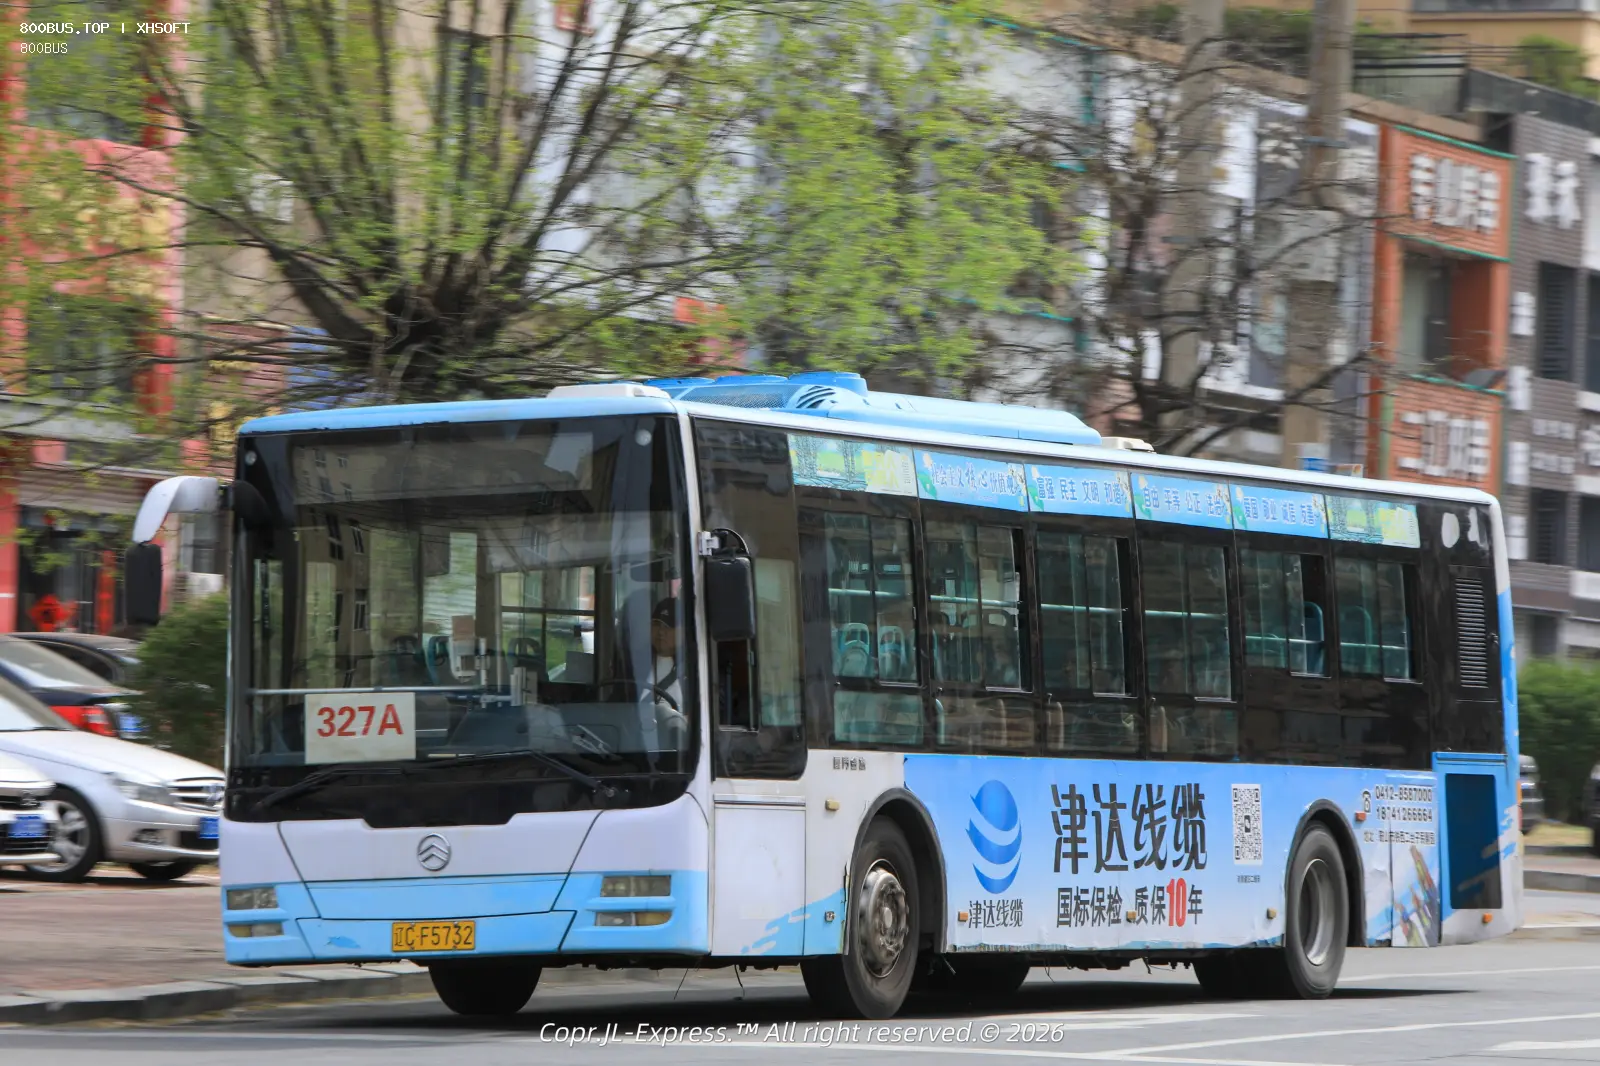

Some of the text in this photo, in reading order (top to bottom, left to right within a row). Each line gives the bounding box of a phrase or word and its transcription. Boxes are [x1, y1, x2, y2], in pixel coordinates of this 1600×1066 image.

[1036, 476, 1122, 506] 富强 民主 文明 和谐
[1143, 486, 1159, 509] 自由
[1164, 488, 1180, 512] 平等
[1185, 490, 1202, 514] 公正
[316, 703, 404, 738] 327A
[1050, 782, 1208, 875] 津达线缆
[968, 899, 1024, 929] 津达线缆
[1056, 877, 1204, 928] 国标保检 质保10年
